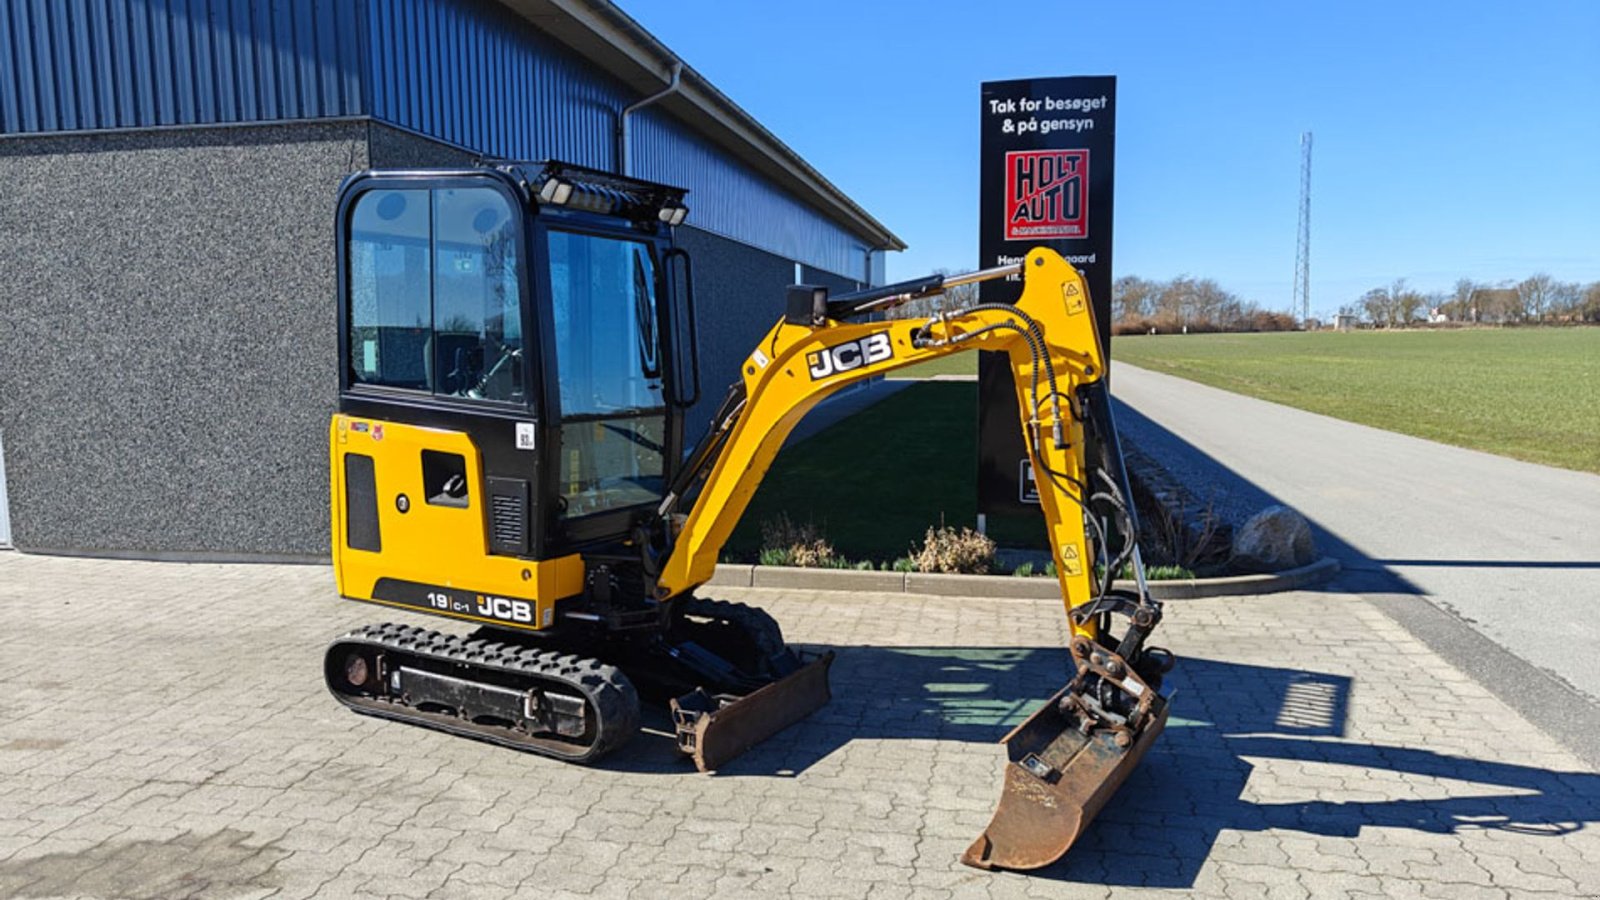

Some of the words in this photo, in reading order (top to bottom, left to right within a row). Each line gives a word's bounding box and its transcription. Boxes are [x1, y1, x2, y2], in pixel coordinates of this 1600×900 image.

[989, 99, 1016, 114] Tak
[1019, 97, 1042, 112] for
[1045, 95, 1107, 112] besøget
[1002, 118, 1015, 133] &
[1017, 116, 1038, 135] på
[1040, 118, 1094, 134] gensyn
[1015, 154, 1082, 202] HOLT
[1011, 174, 1082, 223] AUTO
[808, 332, 892, 379] JCB
[427, 592, 448, 609] 19
[477, 595, 532, 622] JCB
